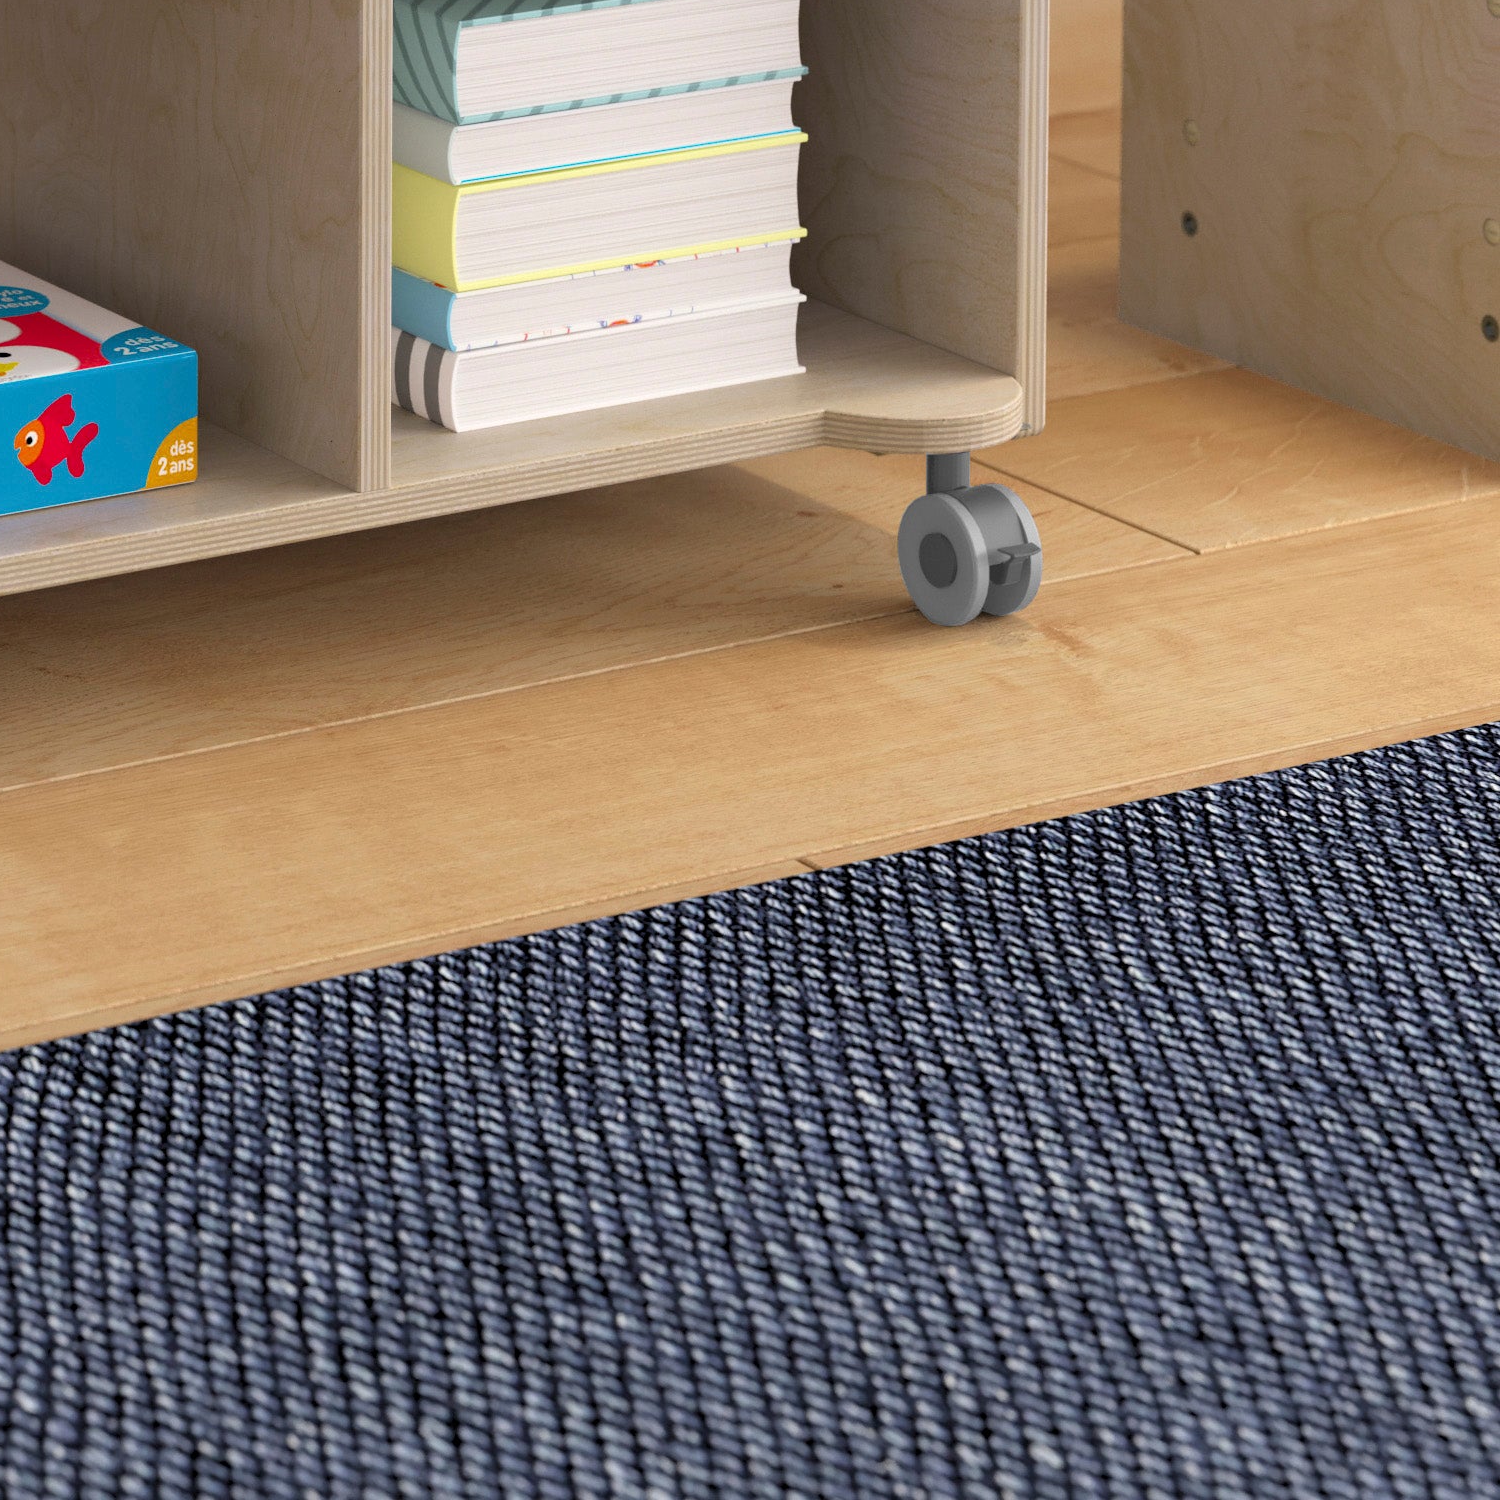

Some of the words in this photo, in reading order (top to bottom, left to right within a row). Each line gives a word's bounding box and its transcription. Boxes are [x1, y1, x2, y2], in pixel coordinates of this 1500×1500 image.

[17, 295, 34, 303] et
[124, 334, 166, 347] dès
[113, 346, 133, 357] 2
[132, 341, 179, 355] ans
[170, 440, 194, 457] dès
[157, 457, 168, 477] 2
[170, 456, 194, 473] ans
